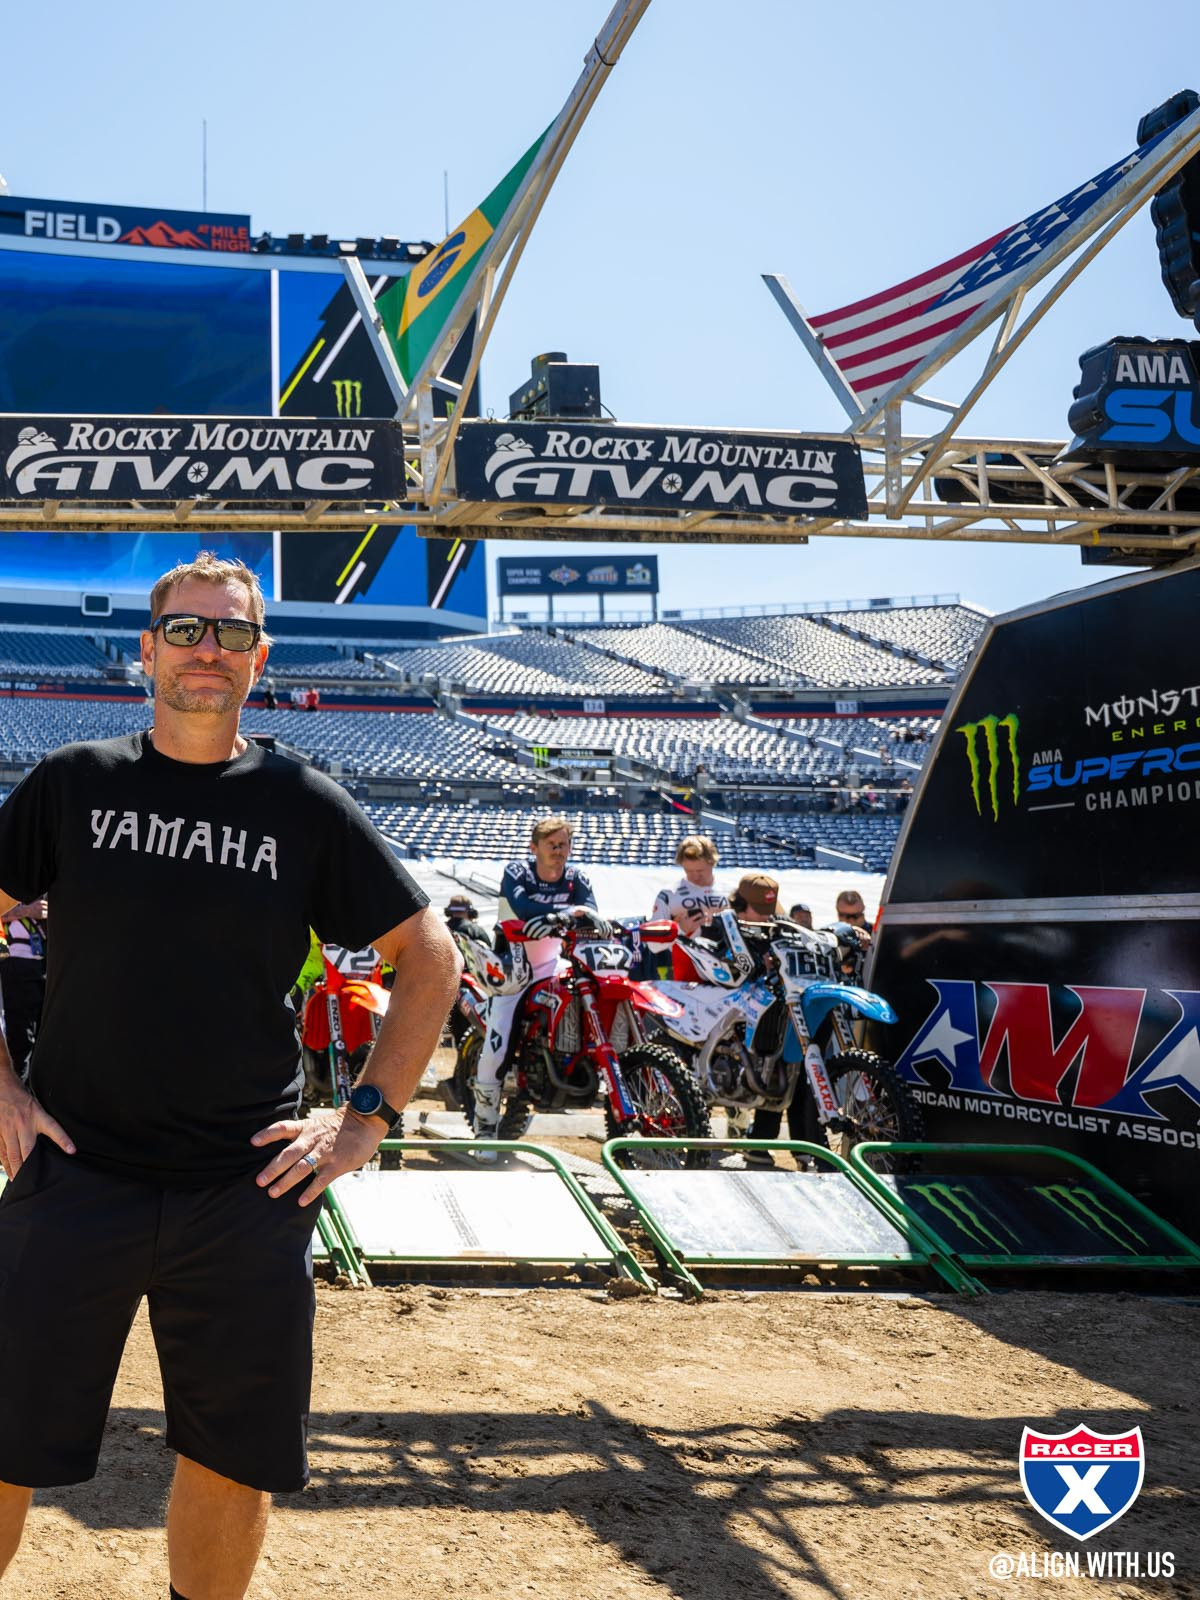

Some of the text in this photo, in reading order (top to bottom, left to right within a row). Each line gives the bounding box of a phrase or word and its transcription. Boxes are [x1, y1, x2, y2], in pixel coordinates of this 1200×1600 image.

[24, 209, 121, 243] FIELD
[211, 226, 249, 241] MILE
[211, 238, 250, 252] HIGH
[1115, 354, 1191, 384] AMA
[63, 422, 375, 452] ROCKY MOUNTAIN
[541, 430, 836, 475] ROCKY MOUNTAIN
[14, 683, 37, 691] FIELD
[1111, 718, 1200, 742] ENER
[1032, 748, 1063, 766] AMA
[1085, 781, 1200, 811] CHAMPIO
[91, 809, 278, 881] YAMAHA
[329, 999, 341, 1033] ENZO
[965, 1097, 1111, 1135] MOTORCYCLIST
